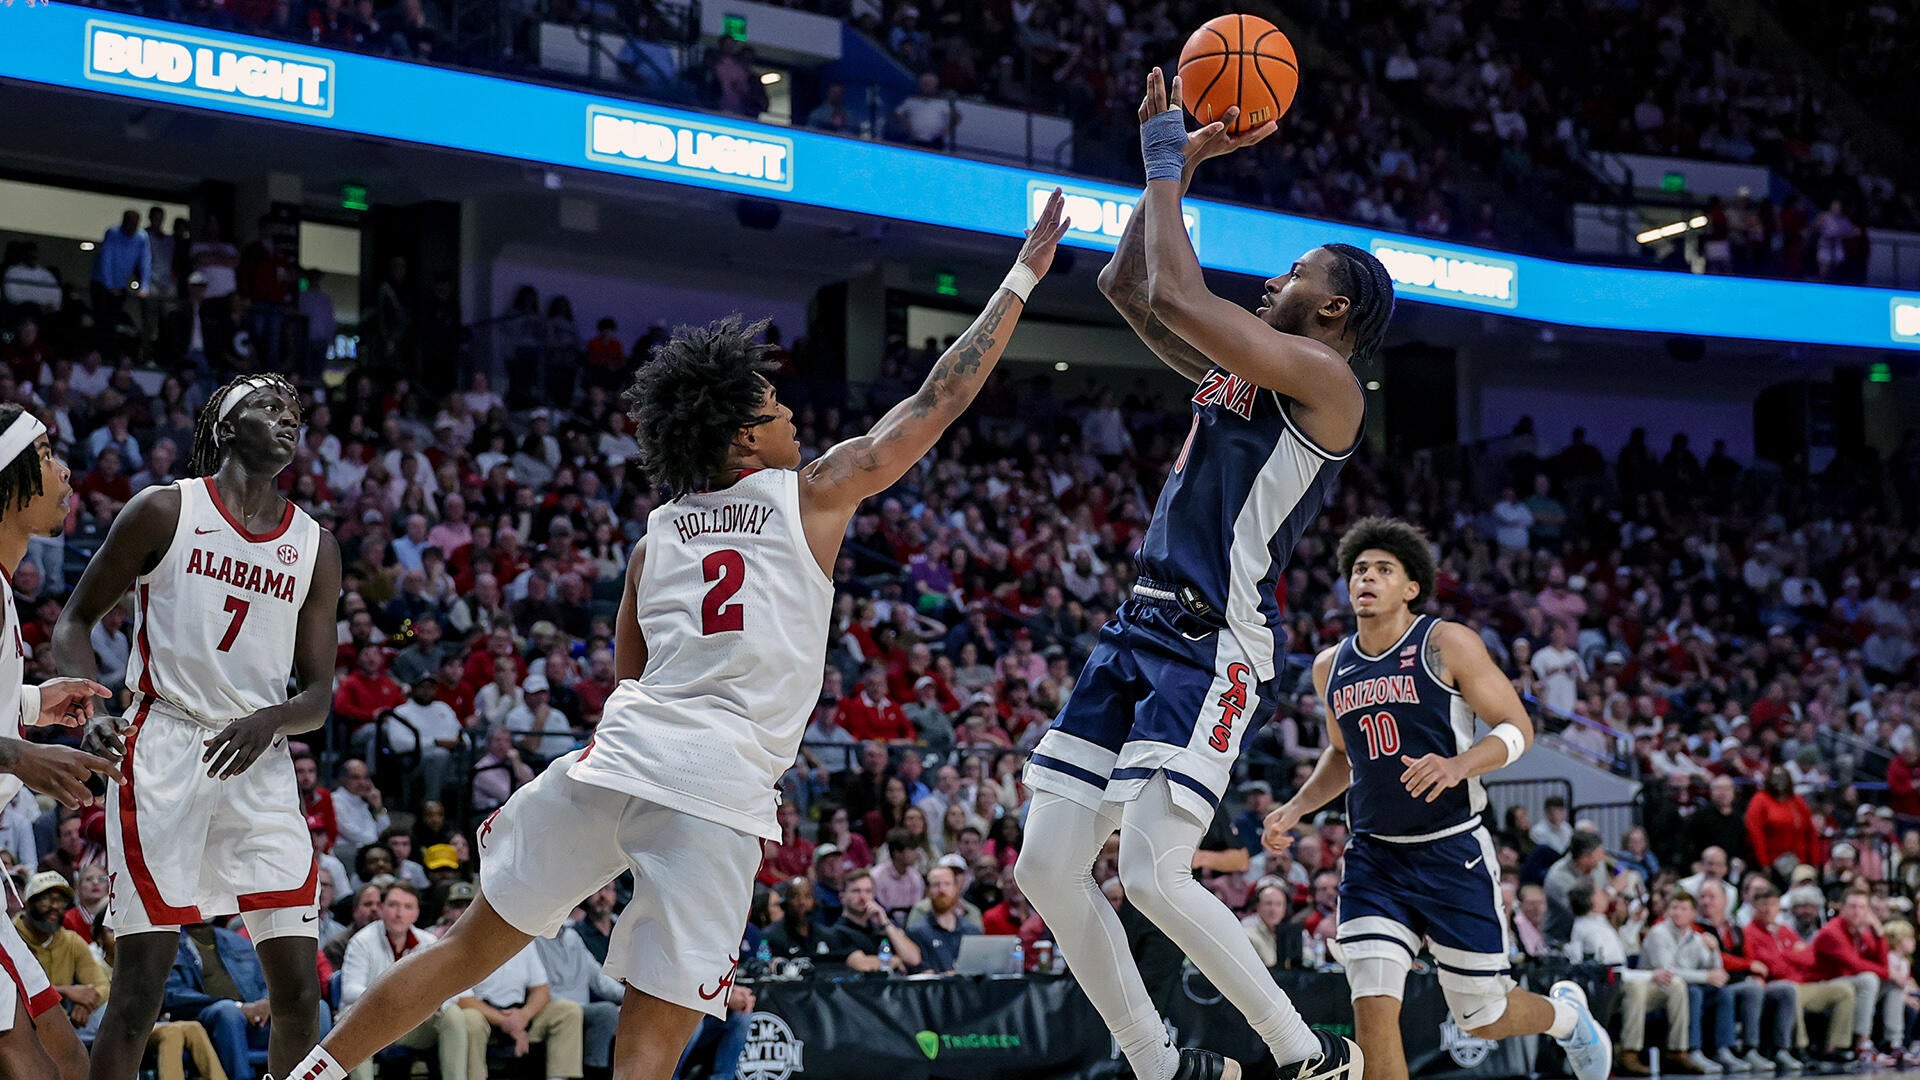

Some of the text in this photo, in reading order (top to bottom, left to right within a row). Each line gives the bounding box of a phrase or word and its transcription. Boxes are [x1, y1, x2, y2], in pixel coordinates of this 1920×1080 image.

[93, 30, 327, 106] BUD LIGHT
[593, 114, 787, 182] BUD LIGHT
[1433, 256, 1514, 300] LIGHT
[673, 503, 774, 544] HOLLOWAY
[186, 548, 296, 604] ALABAMA
[278, 545, 298, 565] SEC
[701, 549, 745, 636] 2
[216, 594, 250, 653] 7
[1209, 662, 1250, 752] CATS
[1333, 675, 1420, 720] ARIZONA
[1358, 711, 1400, 760] 10
